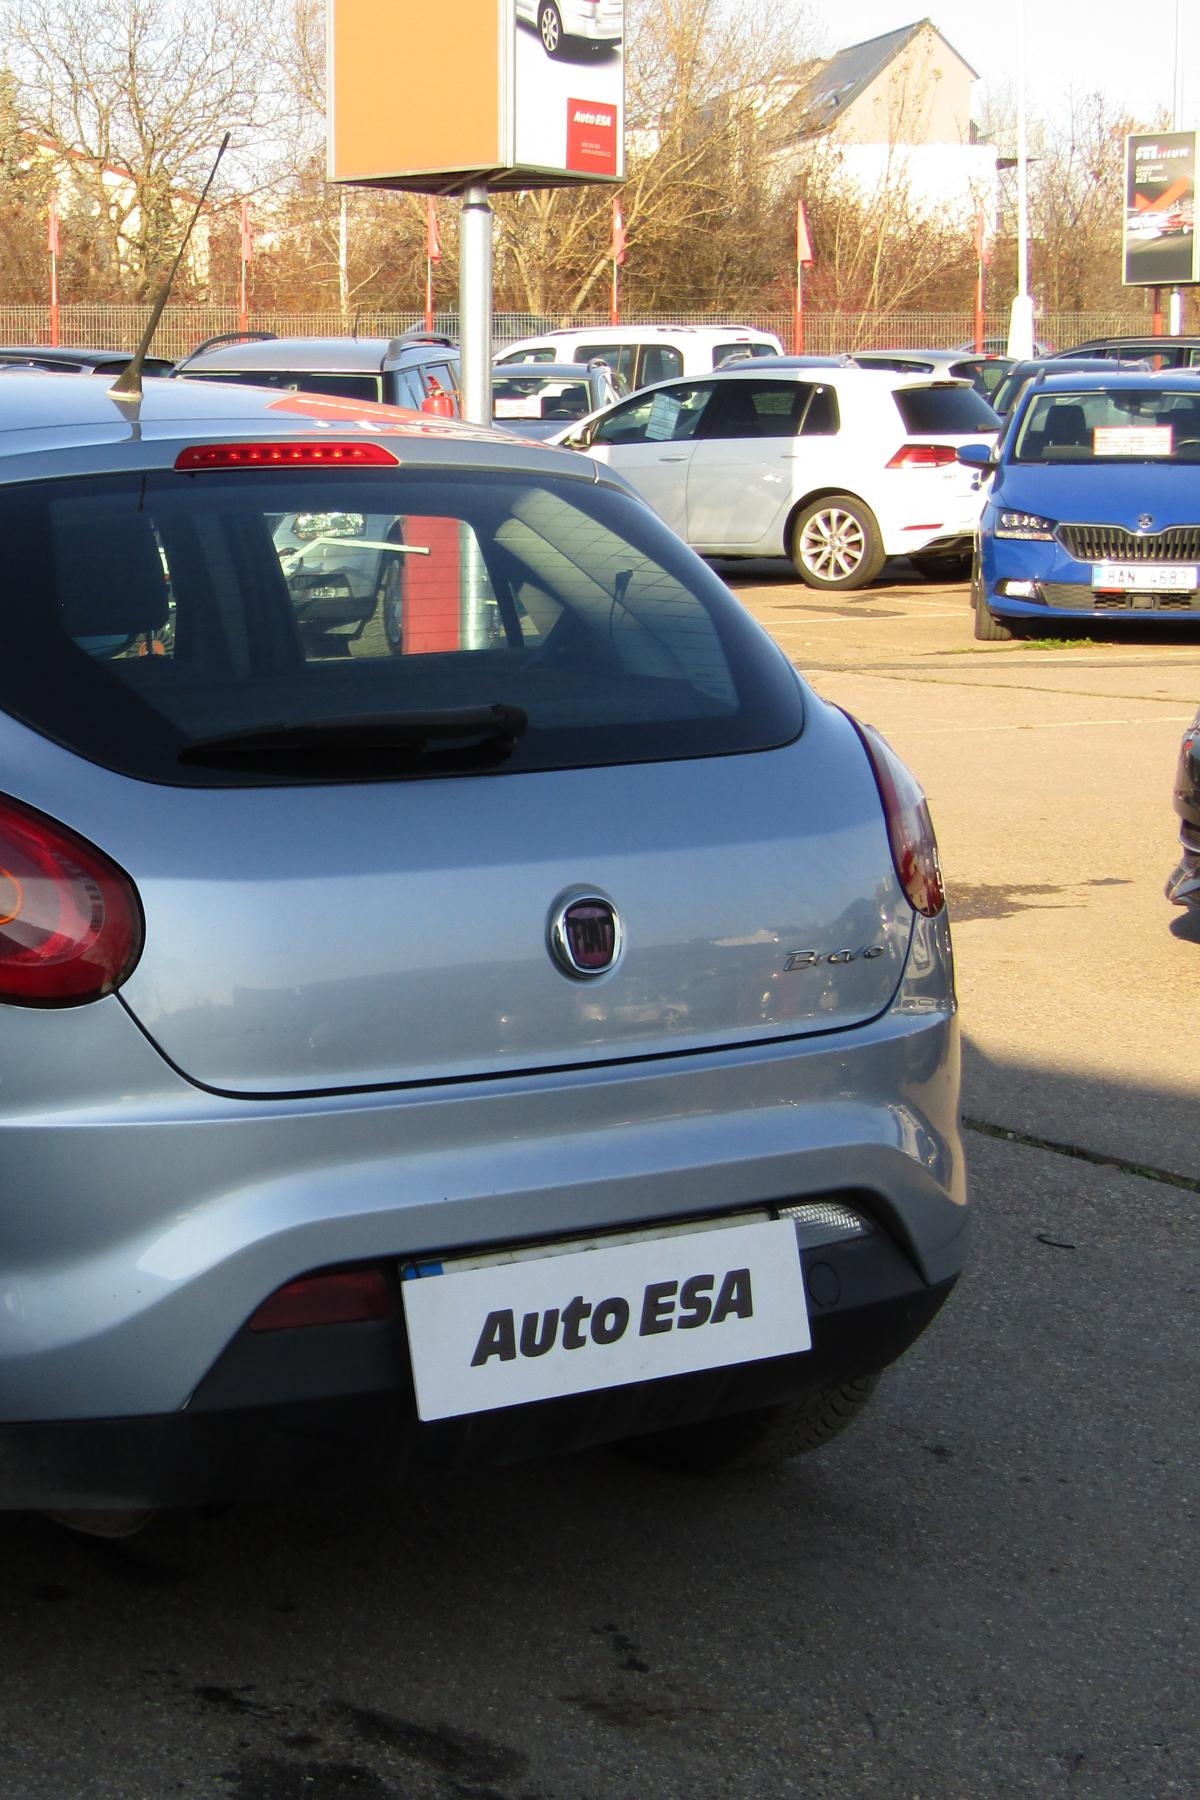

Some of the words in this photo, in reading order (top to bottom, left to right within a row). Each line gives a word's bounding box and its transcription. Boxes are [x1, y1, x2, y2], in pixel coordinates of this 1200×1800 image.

[573, 111, 595, 125] Auto
[595, 114, 611, 127] ESA
[1135, 148, 1189, 160] PREMIUM
[470, 1295, 630, 1368] Auto
[638, 1268, 754, 1337] ESA
